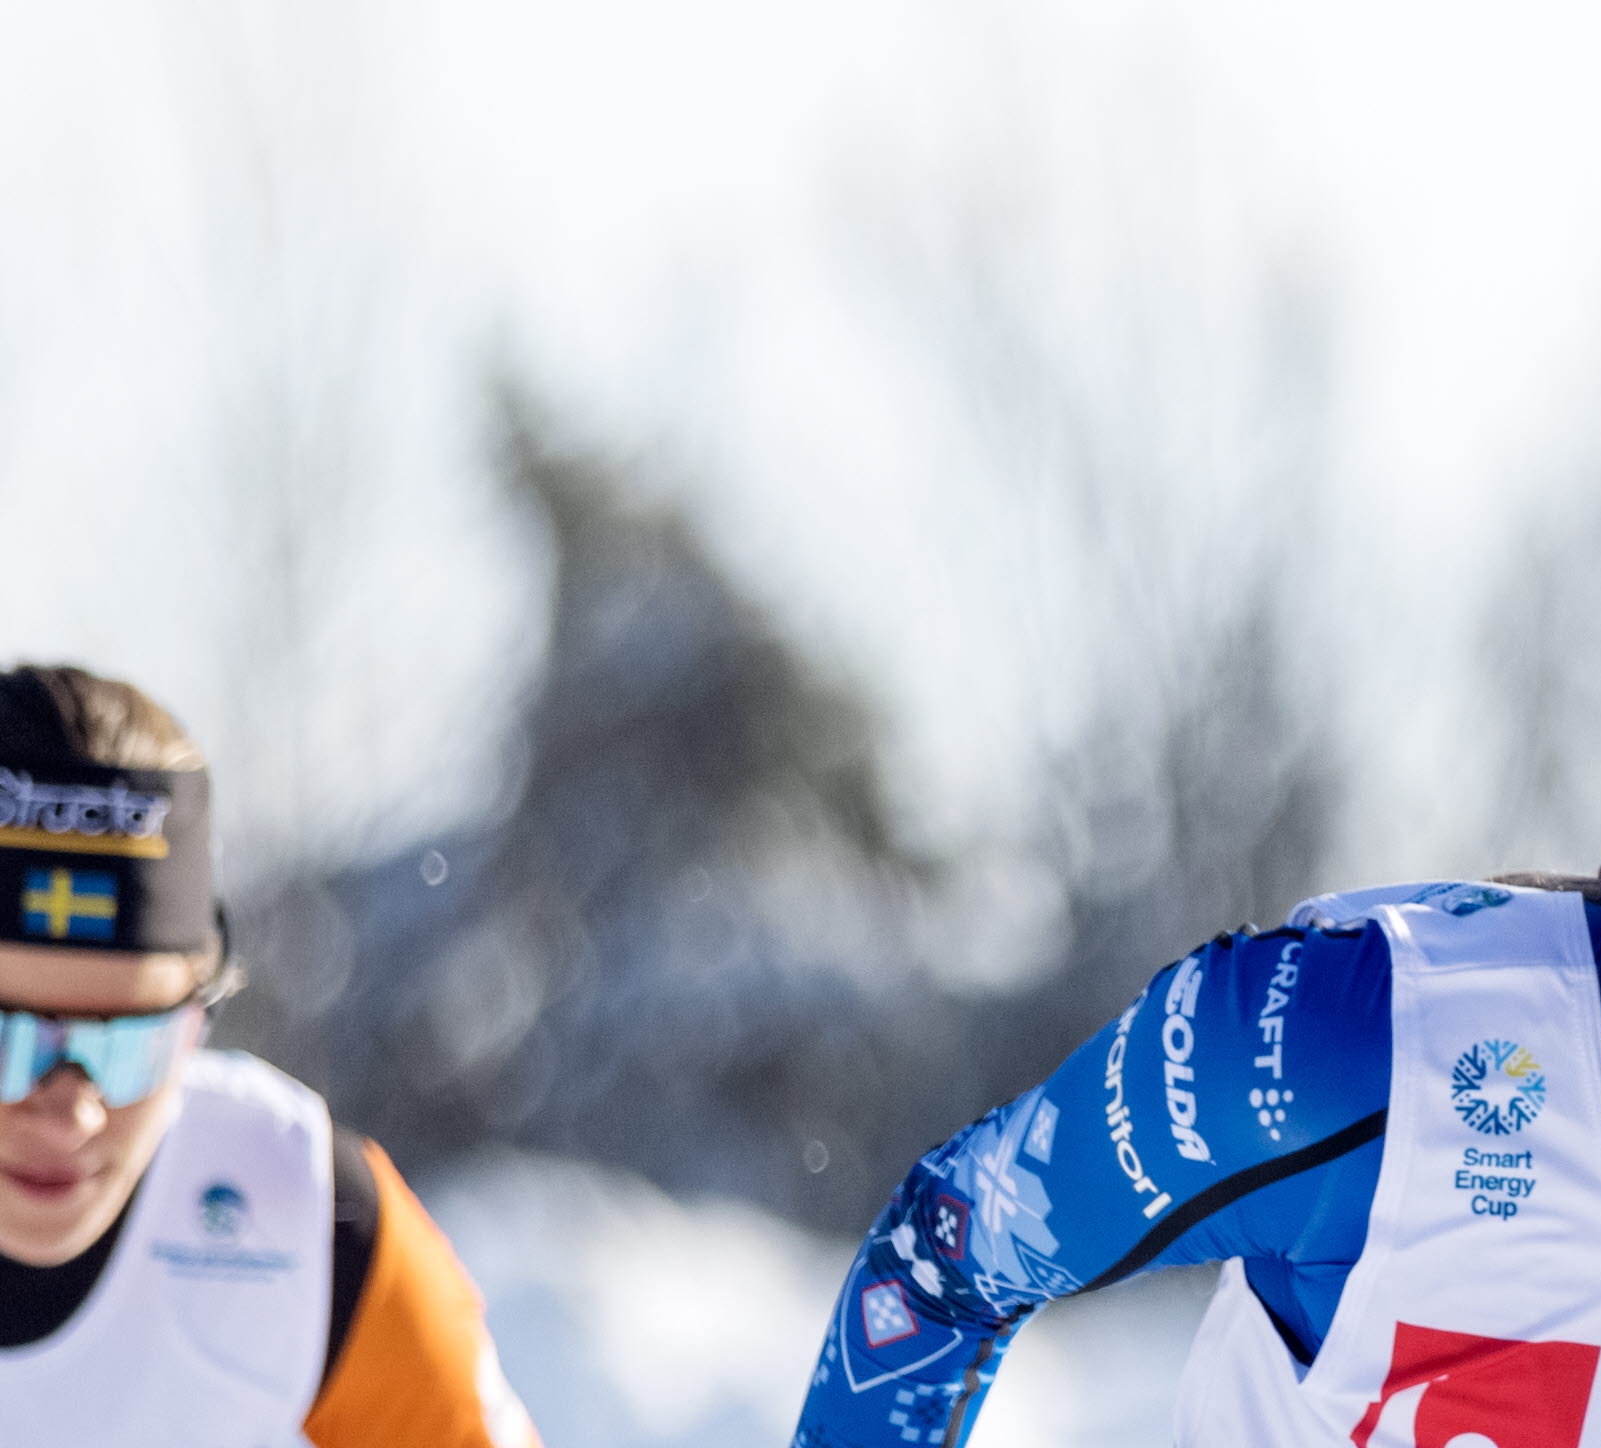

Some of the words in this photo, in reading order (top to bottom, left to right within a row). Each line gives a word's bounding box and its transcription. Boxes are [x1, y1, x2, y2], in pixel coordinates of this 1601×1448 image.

[1253, 942, 1302, 1080] CRAFT
[1463, 1147, 1533, 1169] Smart
[1455, 1170, 1536, 1197] Energy
[1471, 1195, 1517, 1221] Cup
